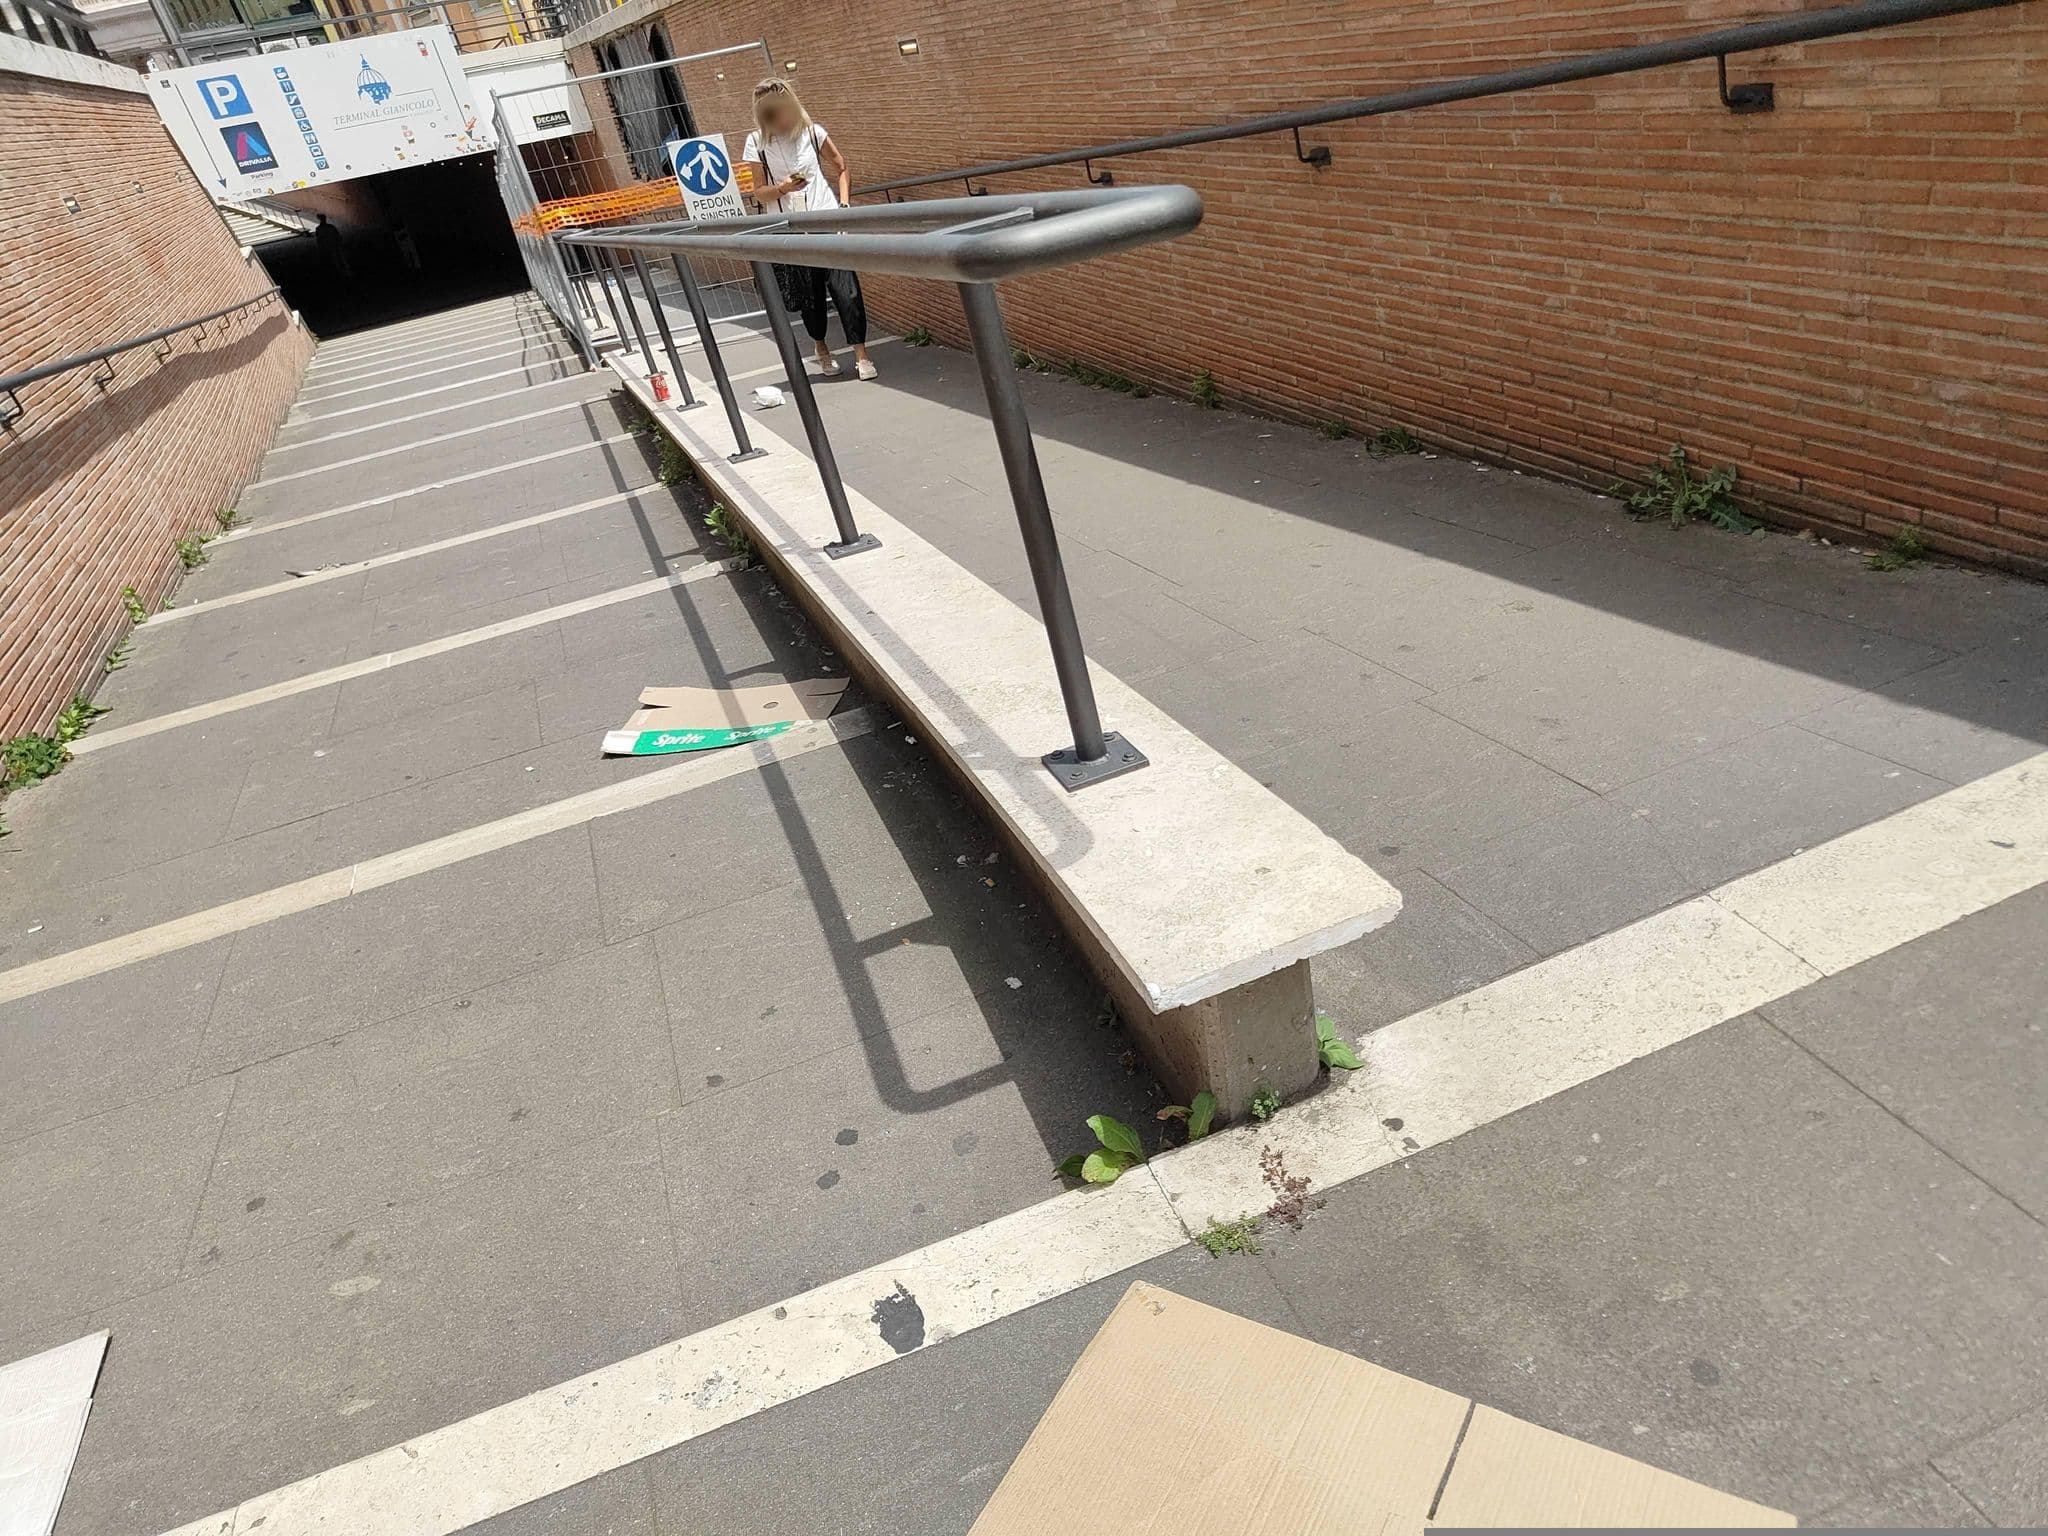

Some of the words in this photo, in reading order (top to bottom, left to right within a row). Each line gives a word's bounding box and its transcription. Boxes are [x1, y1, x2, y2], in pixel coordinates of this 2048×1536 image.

[334, 108, 381, 126] TERMINAL
[382, 98, 434, 115] GIANICOLO
[238, 156, 273, 168] DRIVALIA
[250, 172, 274, 180] Parking
[692, 194, 735, 211] PEDONI
[700, 207, 744, 220] SINISTRA
[651, 733, 706, 747] Sprite
[724, 726, 777, 741] Sprite
